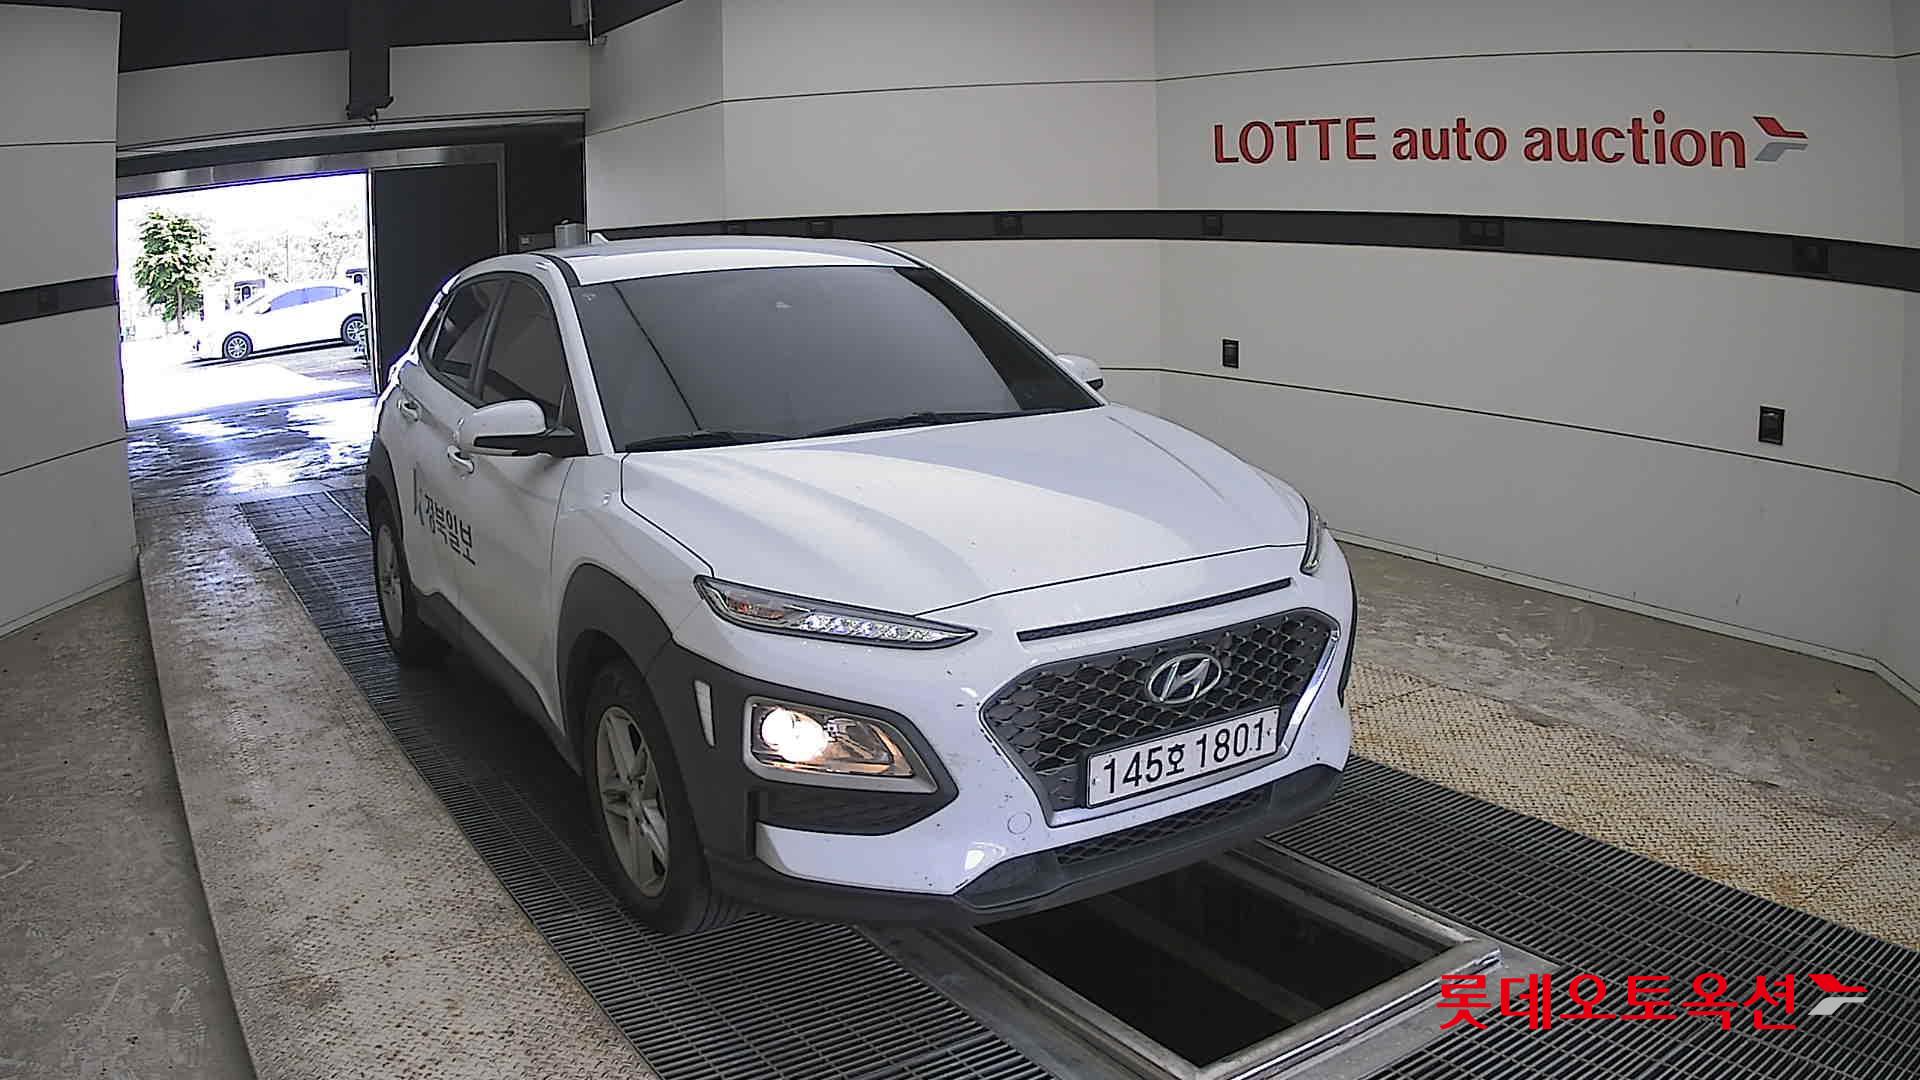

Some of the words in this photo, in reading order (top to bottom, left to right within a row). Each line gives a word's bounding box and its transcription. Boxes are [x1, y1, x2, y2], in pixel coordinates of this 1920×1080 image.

[1214, 116, 1377, 163] LOTTE
[1391, 117, 1508, 162] auto
[1523, 109, 1747, 168] auction
[1103, 743, 1186, 794] 145호
[1195, 717, 1265, 769] 1801
